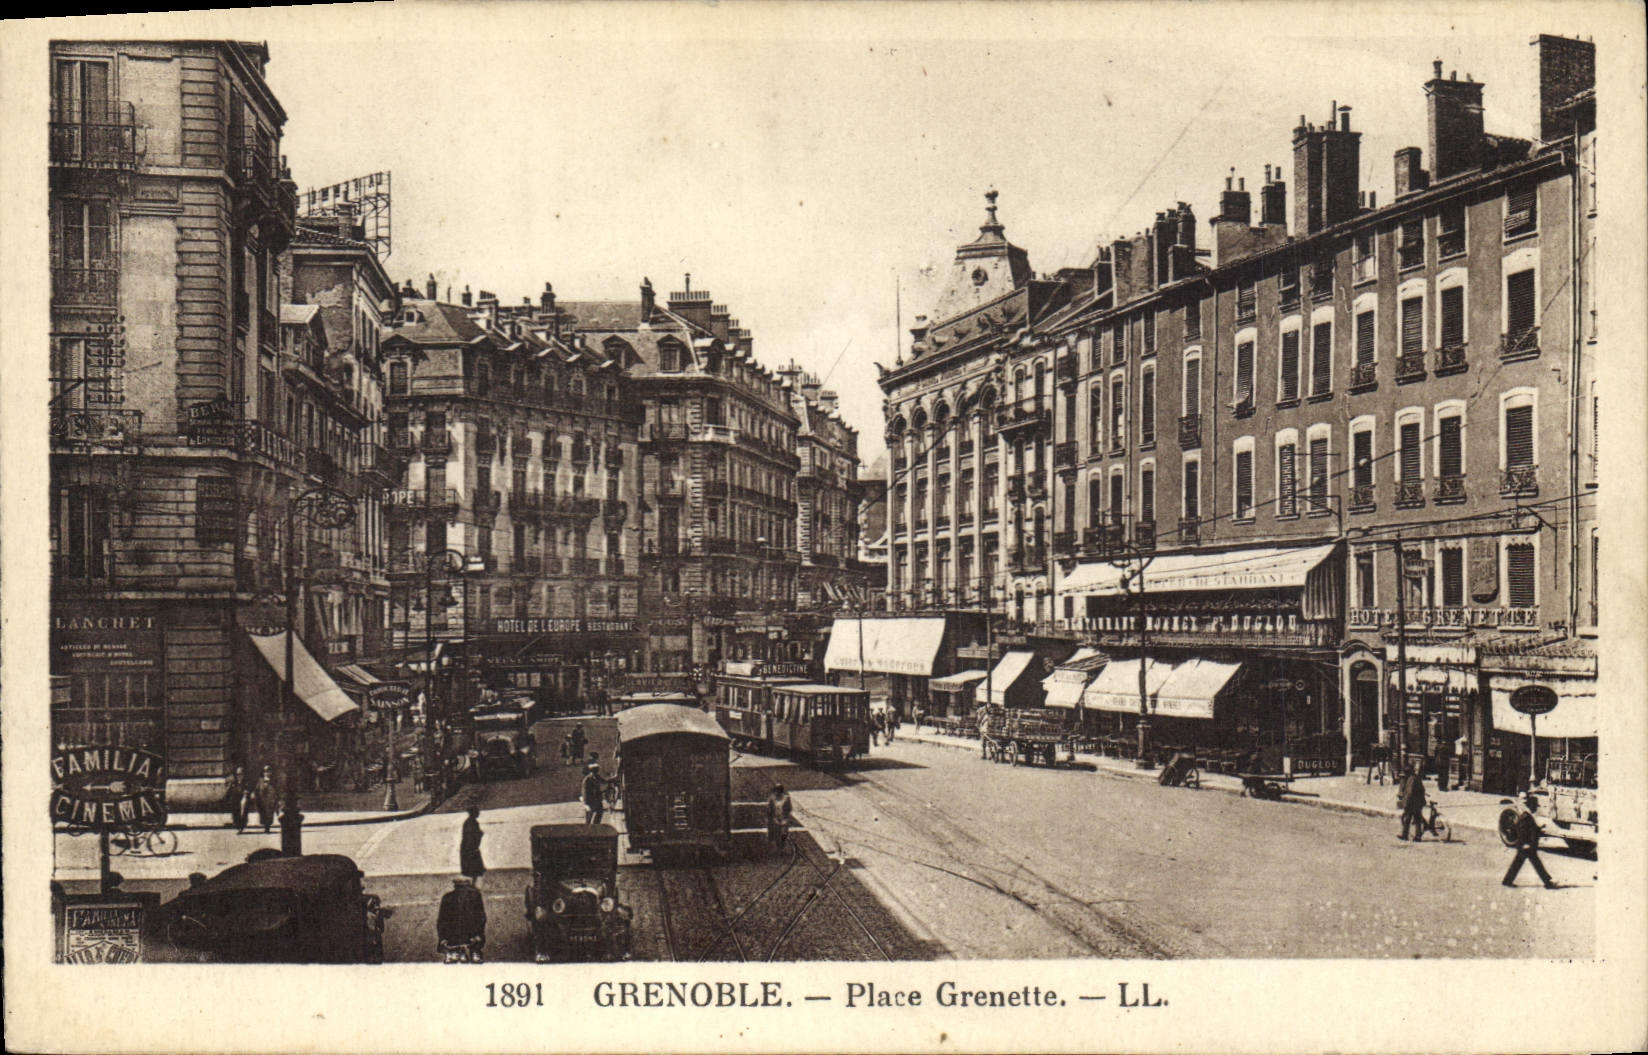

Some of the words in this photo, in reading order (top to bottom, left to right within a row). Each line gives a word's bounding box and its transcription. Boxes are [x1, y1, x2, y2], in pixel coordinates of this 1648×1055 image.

[1422, 608, 1534, 626] GRENETTE
[497, 620, 526, 633] HOTEL
[528, 620, 539, 633] DE
[587, 621, 633, 632] RESTAURANT
[1298, 760, 1338, 769] DUGLOU
[56, 796, 155, 823] CINEMA
